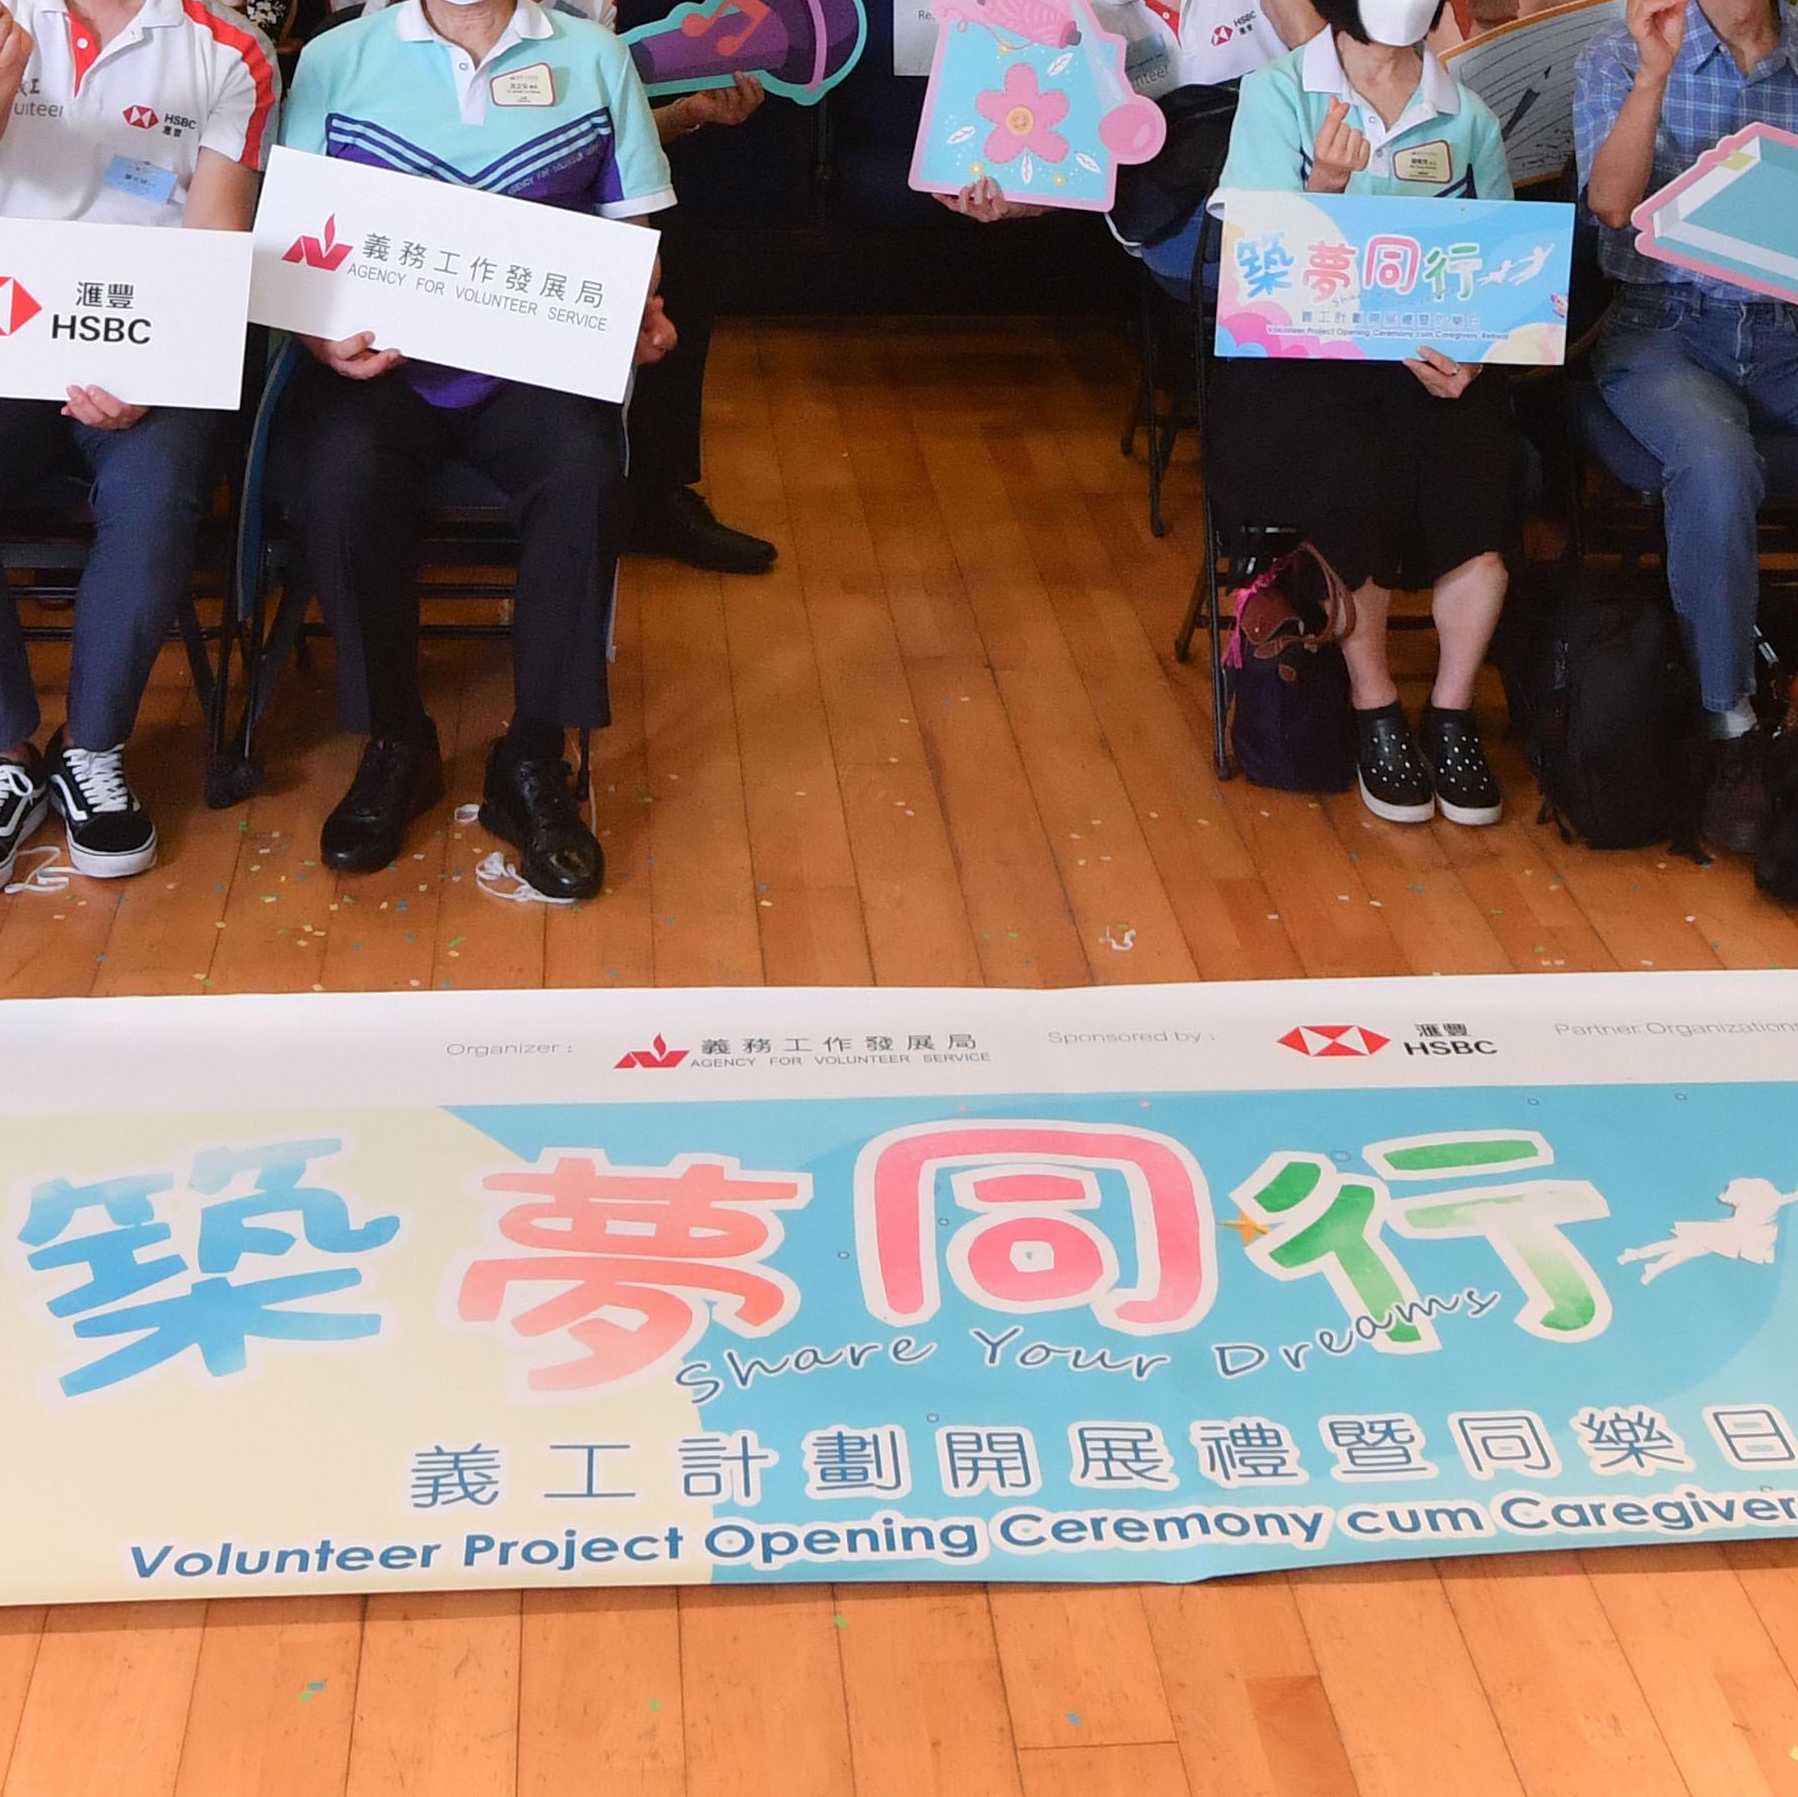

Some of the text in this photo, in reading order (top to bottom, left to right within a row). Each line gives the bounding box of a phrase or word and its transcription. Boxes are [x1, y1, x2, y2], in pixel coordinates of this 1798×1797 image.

[164, 113, 196, 130] HSBC
[362, 232, 603, 308] 義務工作發展局
[1236, 232, 1483, 303] 築夢同行
[75, 281, 134, 309] 滙豐
[347, 263, 608, 332] AGENCY FOR VOLUNTEER SERVICE
[51, 314, 151, 344] HSBC
[1048, 1028, 1169, 1046] Sponsored
[1174, 1029, 1202, 1045] by
[1415, 1023, 1469, 1038] 滙豐
[1554, 1020, 1640, 1037] Partner
[446, 1042, 560, 1059] Organizer
[701, 1033, 976, 1055] 義務工作發展局
[1403, 1040, 1498, 1057] HSBC
[690, 1052, 991, 1068] AGENCY FOR VOLUNTEER SERVICE
[15, 1124, 1608, 1399] 築夢同行
[676, 1286, 1498, 1404] Share Your Dreams
[411, 1406, 1797, 1509] 義工計劃開展禮暨同樂日
[130, 1538, 440, 1579] Volunteer
[463, 1526, 683, 1574] Project
[705, 1516, 978, 1562] Opening
[1000, 1508, 1323, 1548] Ceremony
[1346, 1506, 1484, 1536] cum
